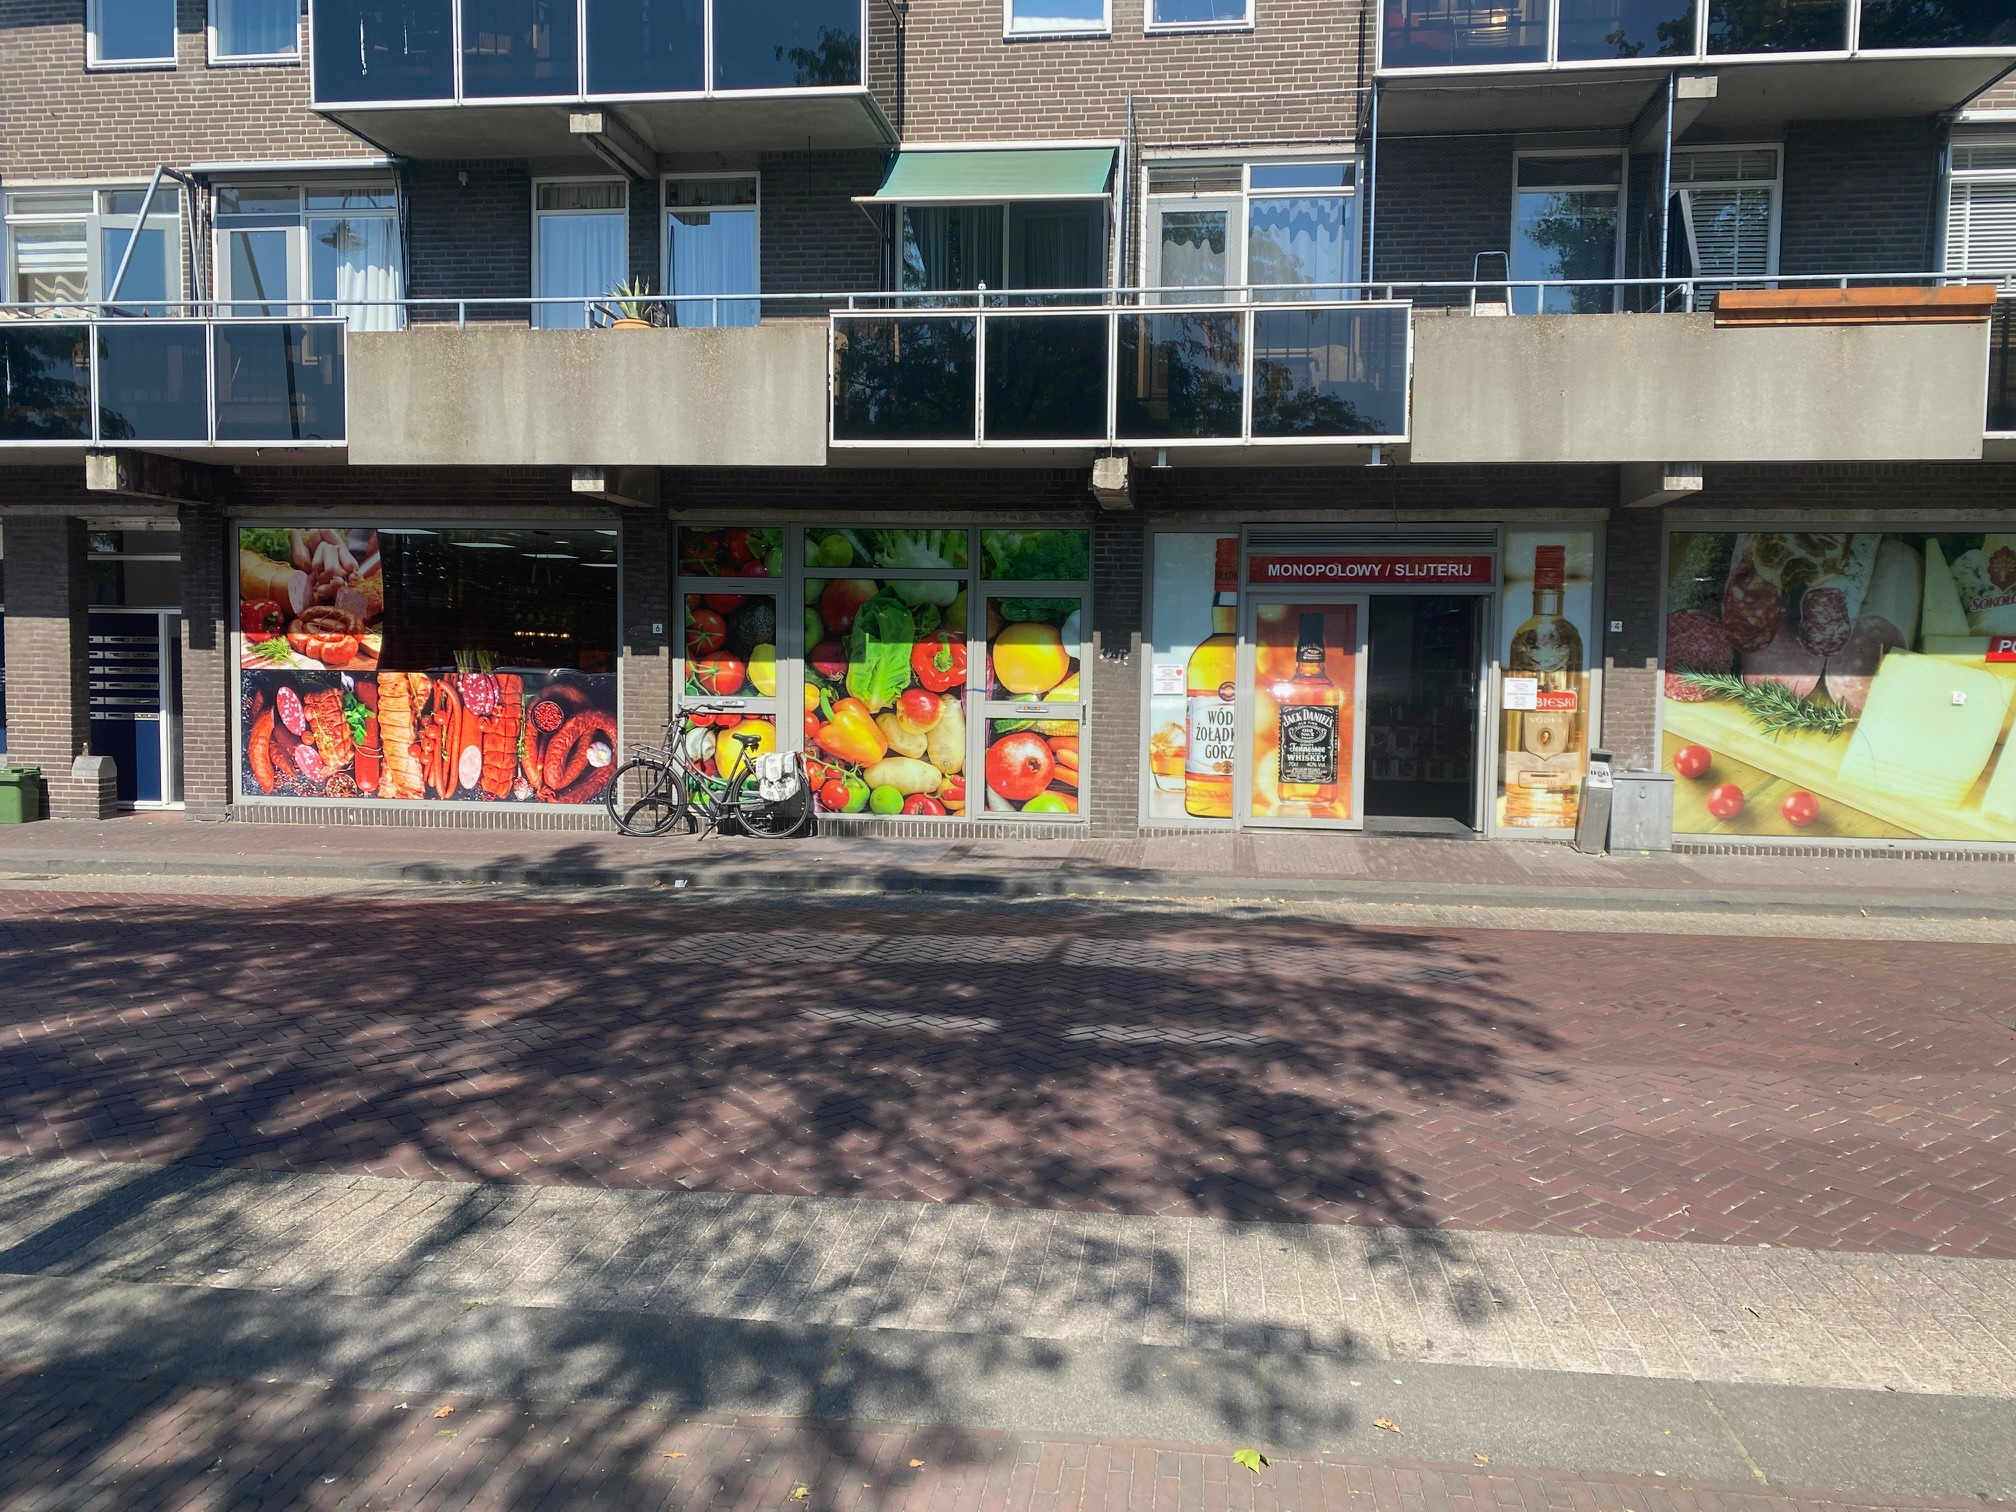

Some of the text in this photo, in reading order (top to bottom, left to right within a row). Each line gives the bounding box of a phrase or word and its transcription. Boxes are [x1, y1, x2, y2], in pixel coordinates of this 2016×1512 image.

[1268, 563, 1472, 577] MONOPOLOWY / SLIJTERIJ
[1283, 711, 1303, 728] JACK
[1530, 716, 1563, 724] VODKA
[1289, 743, 1326, 753] Tennessee
[1287, 754, 1327, 762] WHISKEY
